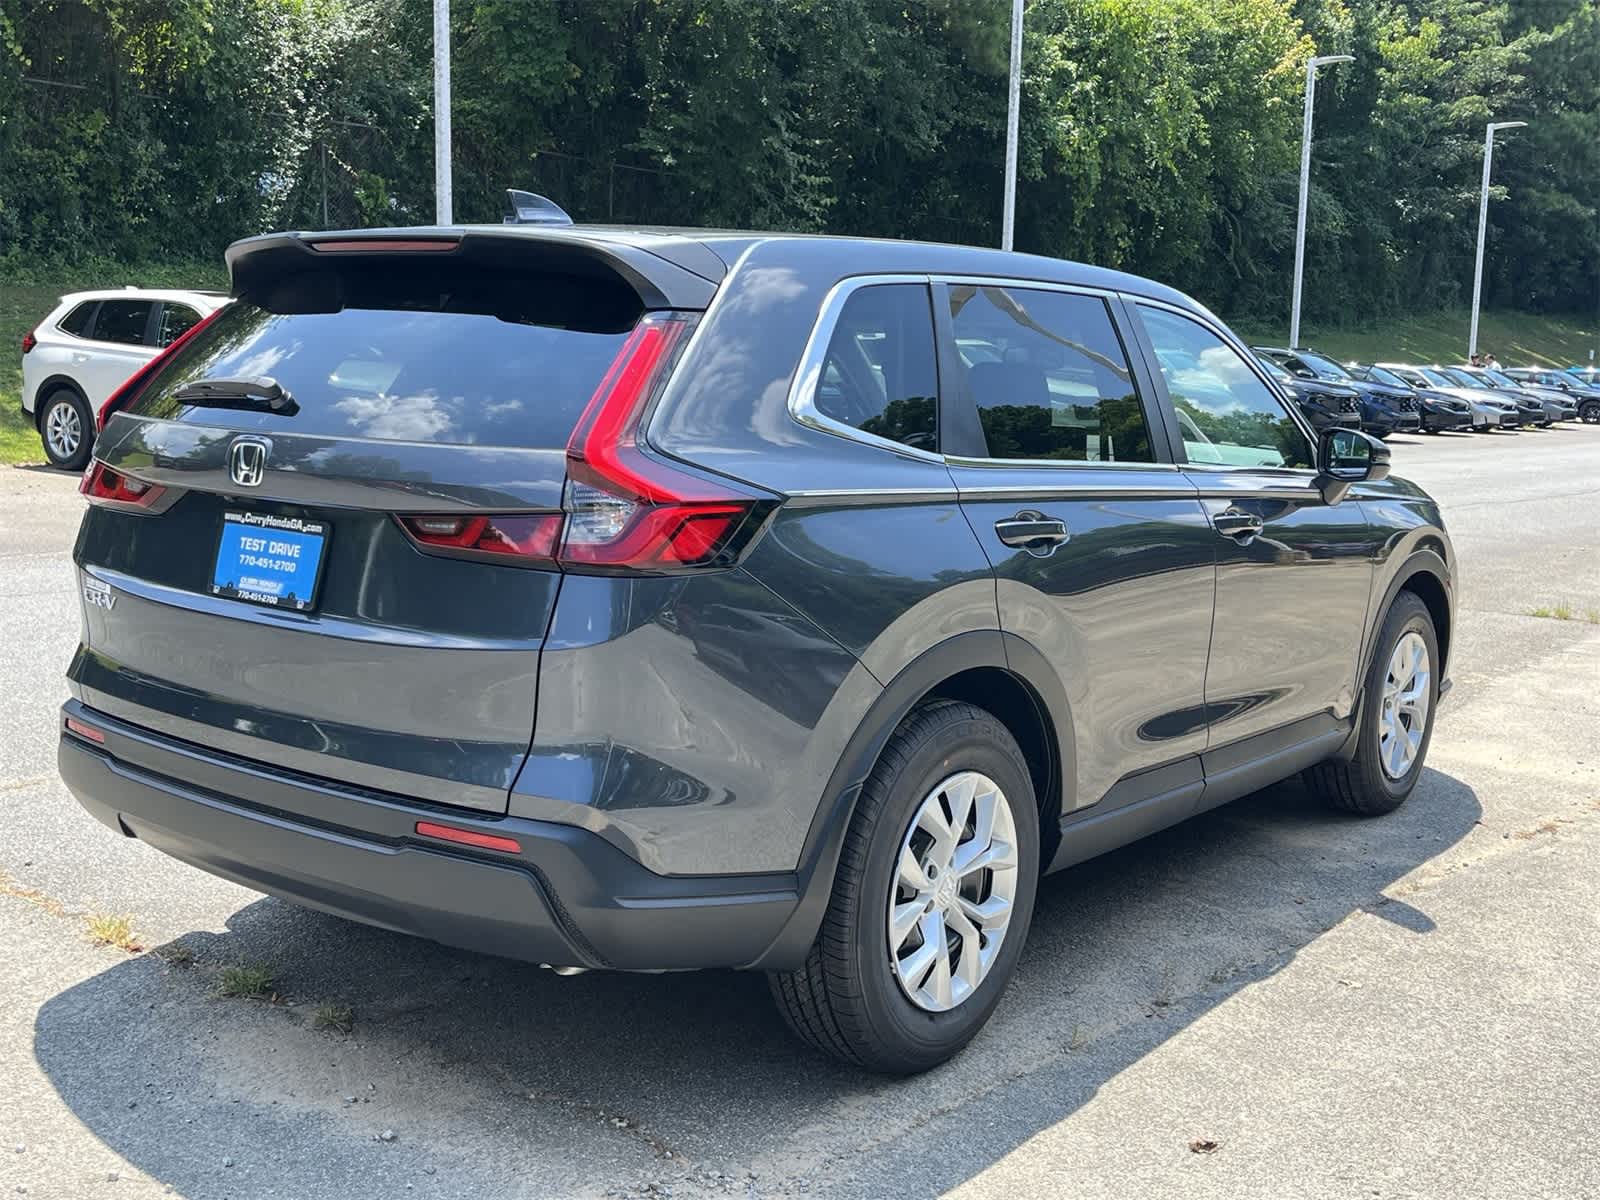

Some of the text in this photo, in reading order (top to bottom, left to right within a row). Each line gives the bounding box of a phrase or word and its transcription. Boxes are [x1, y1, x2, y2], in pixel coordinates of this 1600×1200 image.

[224, 512, 323, 533] www.CurryHondaGA.com
[240, 536, 301, 558] TEST DRIVE
[239, 554, 296, 573] 770-451-2700
[237, 589, 279, 605] 770-451-2700
